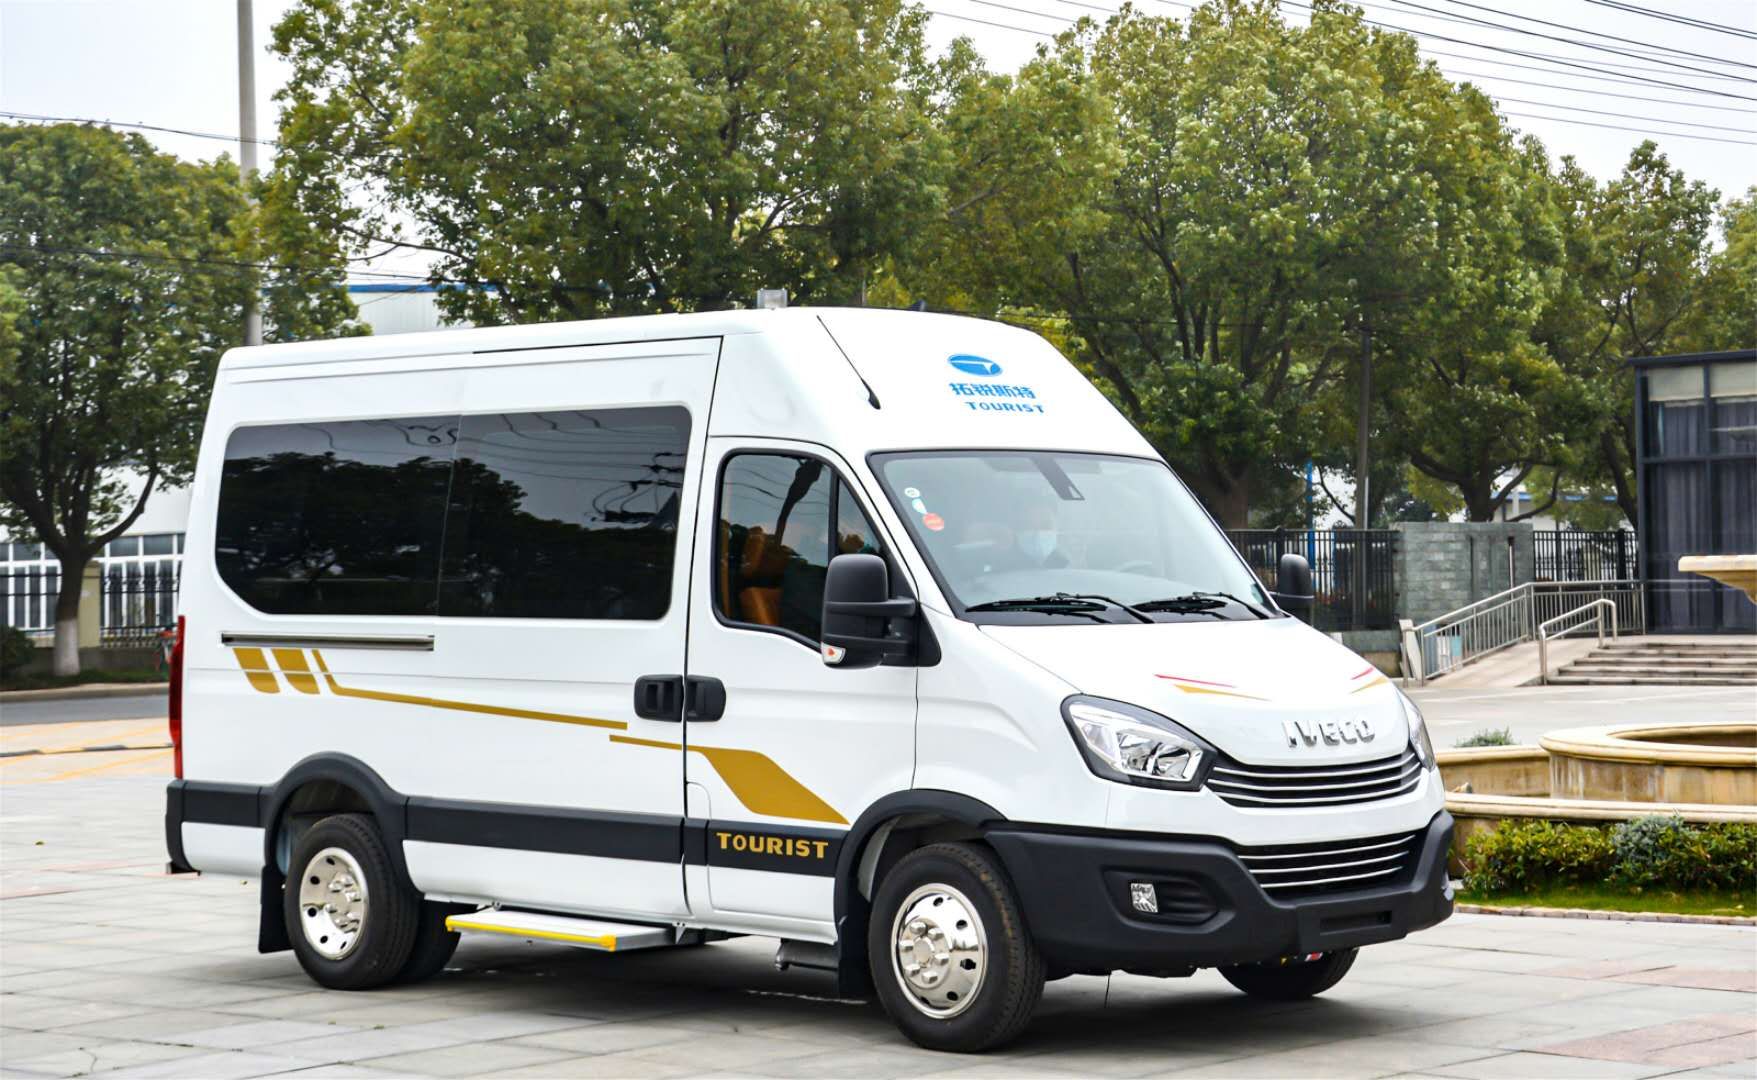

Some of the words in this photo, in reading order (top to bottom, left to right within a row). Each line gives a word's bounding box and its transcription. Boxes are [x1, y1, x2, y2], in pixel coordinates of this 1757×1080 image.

[949, 383, 1036, 399] 拓锐斯特
[965, 401, 1044, 413] TOURIST
[1282, 718, 1375, 747] IVECO
[716, 832, 829, 859] TOURIST
